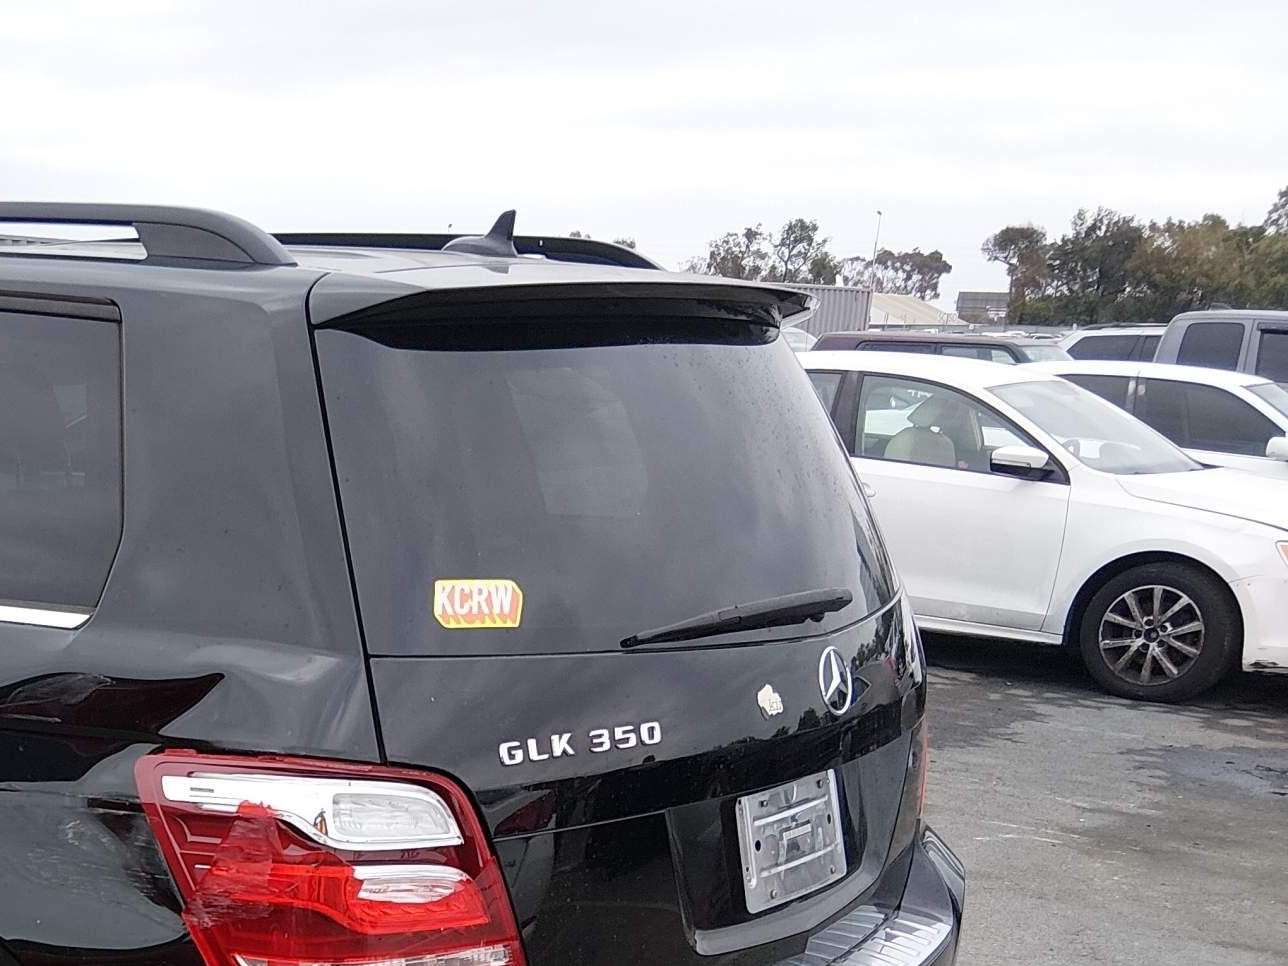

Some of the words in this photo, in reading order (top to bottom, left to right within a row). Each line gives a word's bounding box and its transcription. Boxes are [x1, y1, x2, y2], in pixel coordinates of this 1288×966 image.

[435, 582, 516, 618] KCRW
[498, 732, 576, 767] GLK
[588, 720, 663, 754] 350
